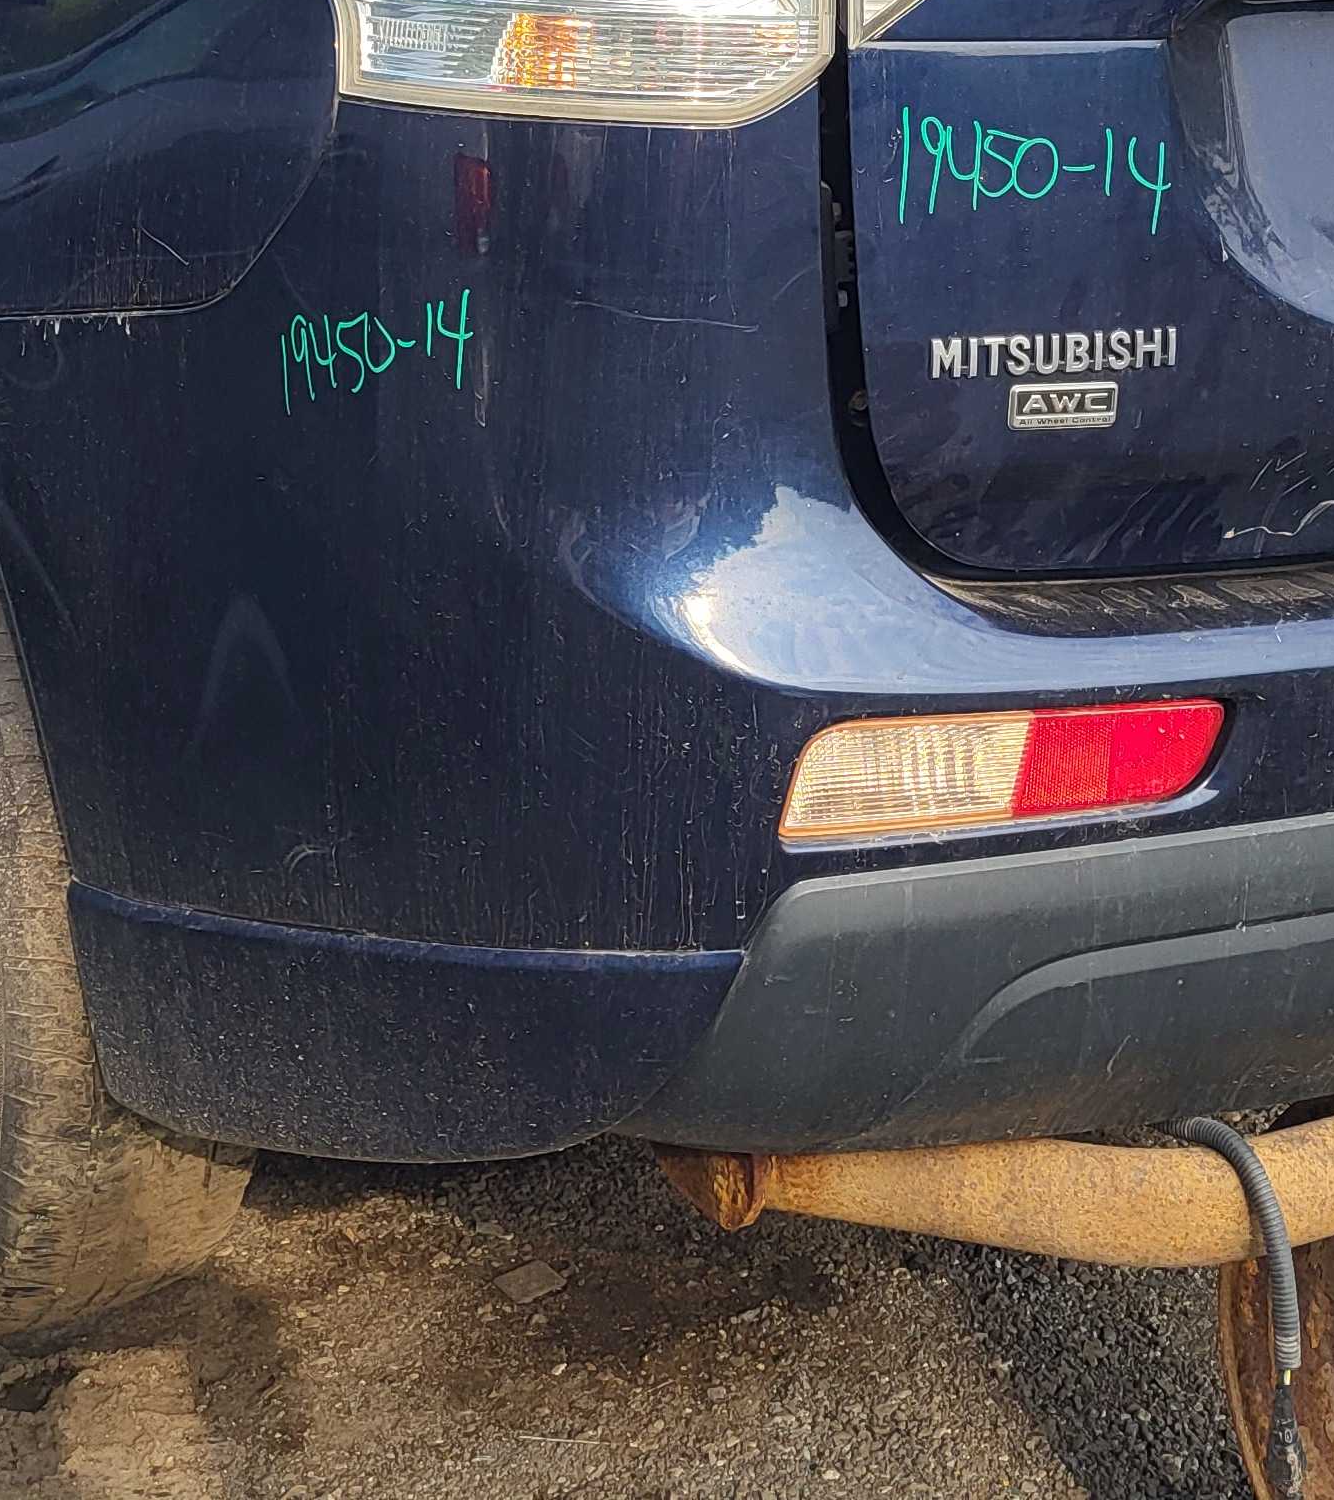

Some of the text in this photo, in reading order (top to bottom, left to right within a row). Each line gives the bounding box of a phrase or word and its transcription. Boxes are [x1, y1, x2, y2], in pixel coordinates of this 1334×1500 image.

[899, 106, 1171, 235] 19450-14
[280, 288, 474, 415] 19450-14
[929, 326, 1178, 380] MITSUBISHI
[1019, 418, 1033, 426] All
[1072, 416, 1111, 424] Control
[1022, 392, 1108, 413] AWC
